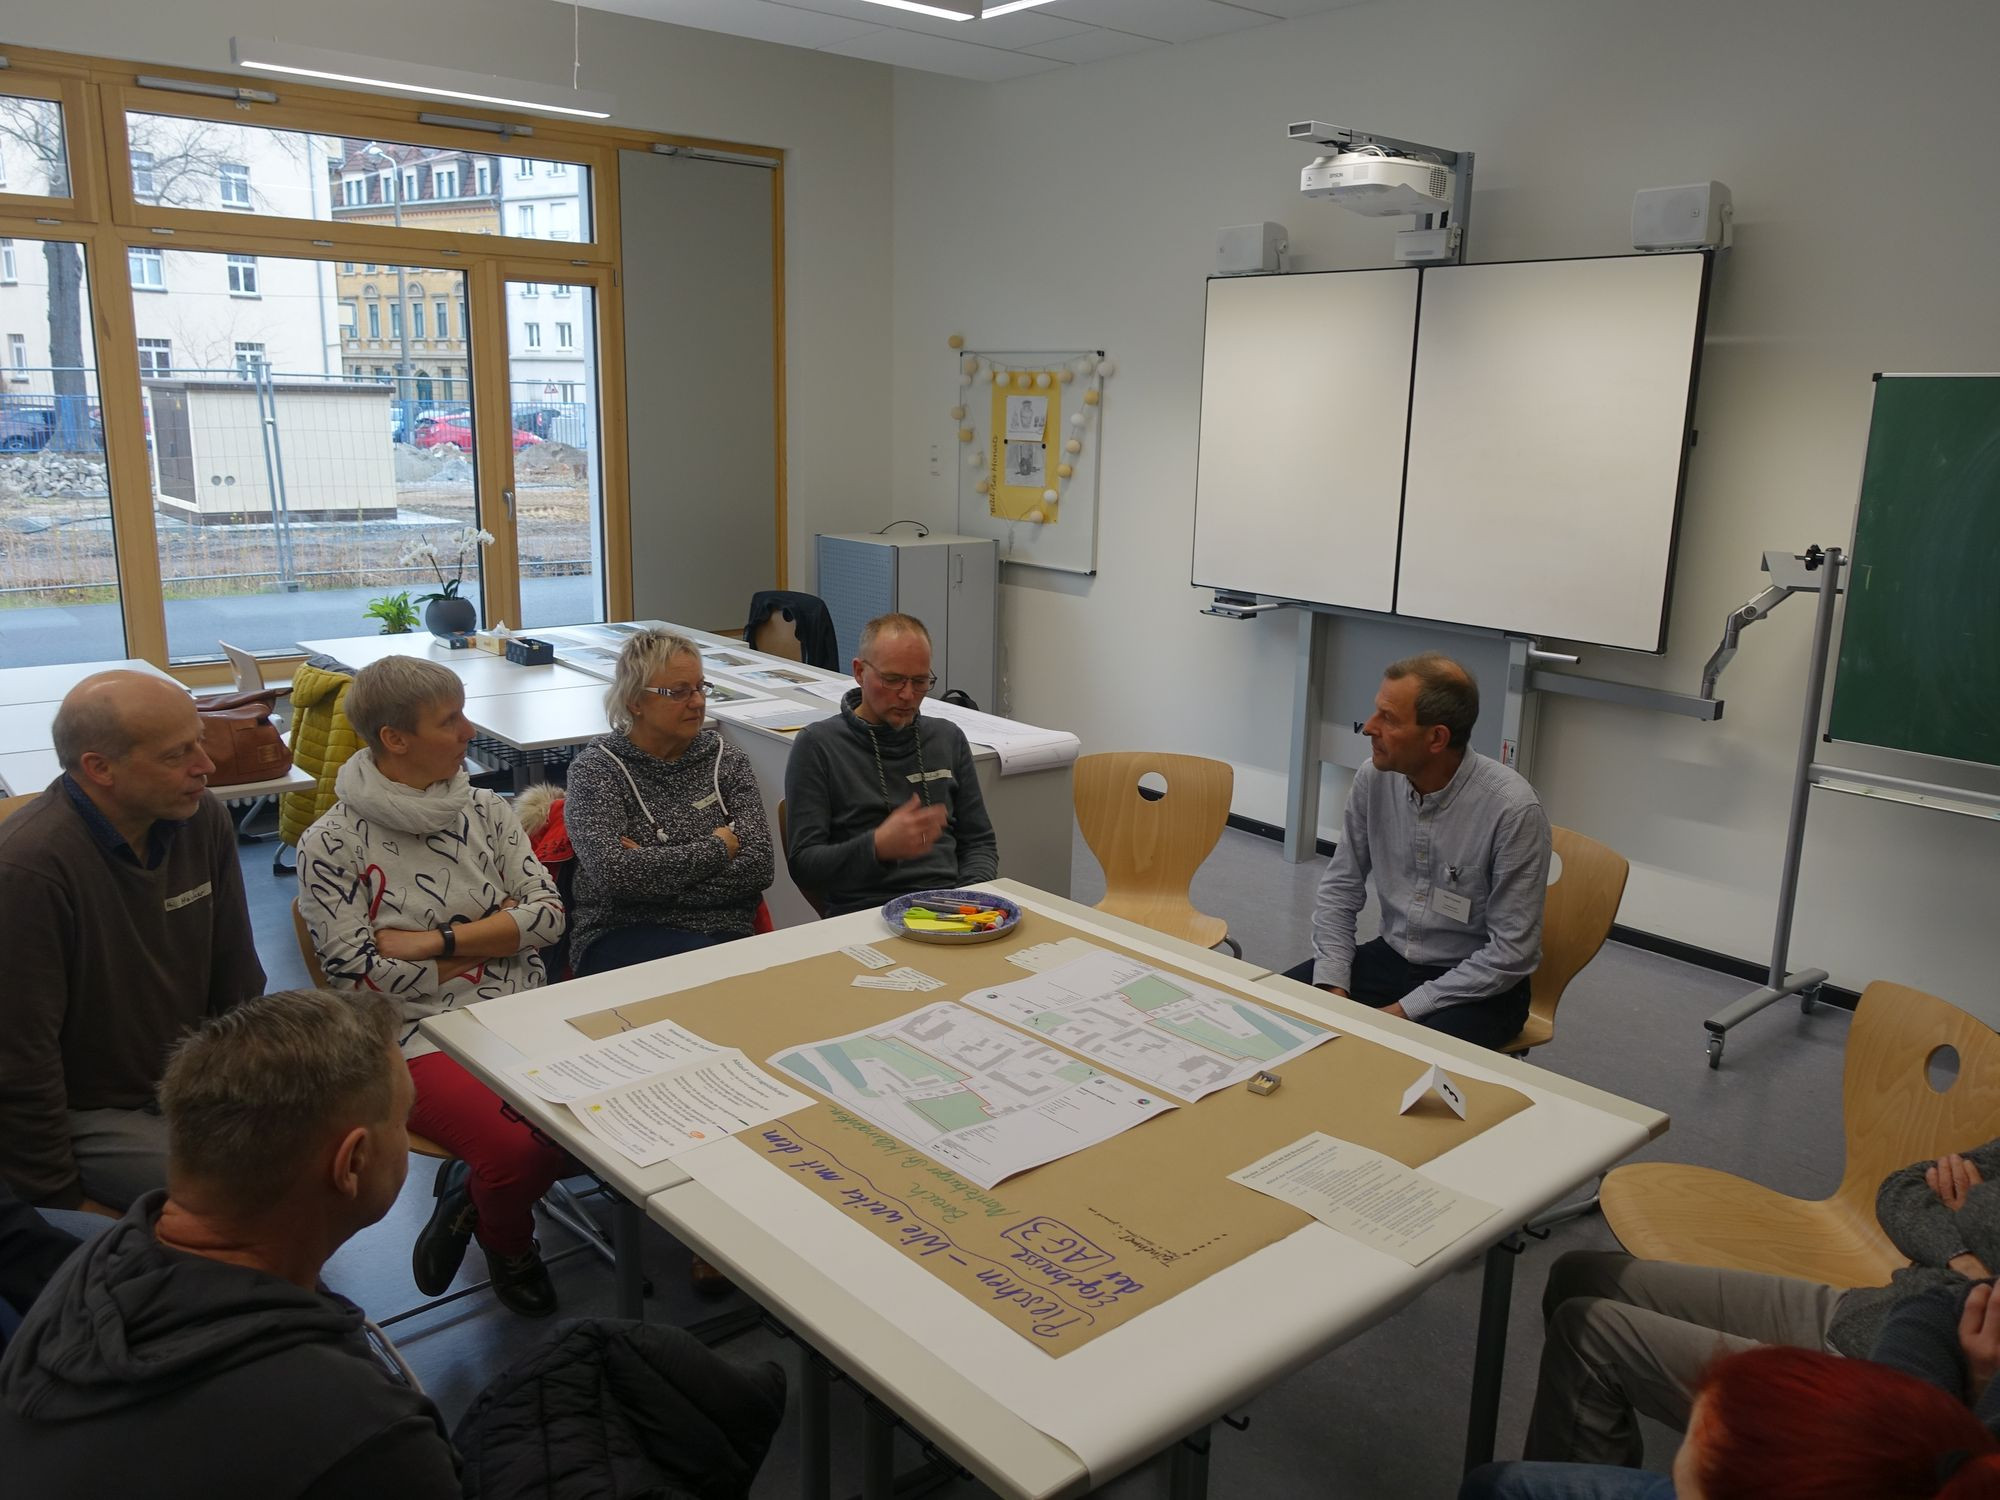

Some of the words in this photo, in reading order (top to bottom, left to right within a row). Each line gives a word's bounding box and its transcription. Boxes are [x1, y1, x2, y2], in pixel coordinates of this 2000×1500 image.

[1443, 1083, 1459, 1103] 3
[762, 1129, 804, 1153] dem
[789, 1160, 845, 1181] mit
[840, 1188, 904, 1223] weiter
[906, 1182, 968, 1224] Bereich
[900, 1223, 951, 1256] Wie
[1010, 1248, 1119, 1308] Ergebnisse
[1102, 1271, 1144, 1295] der
[976, 1268, 1081, 1338] Pieschen
